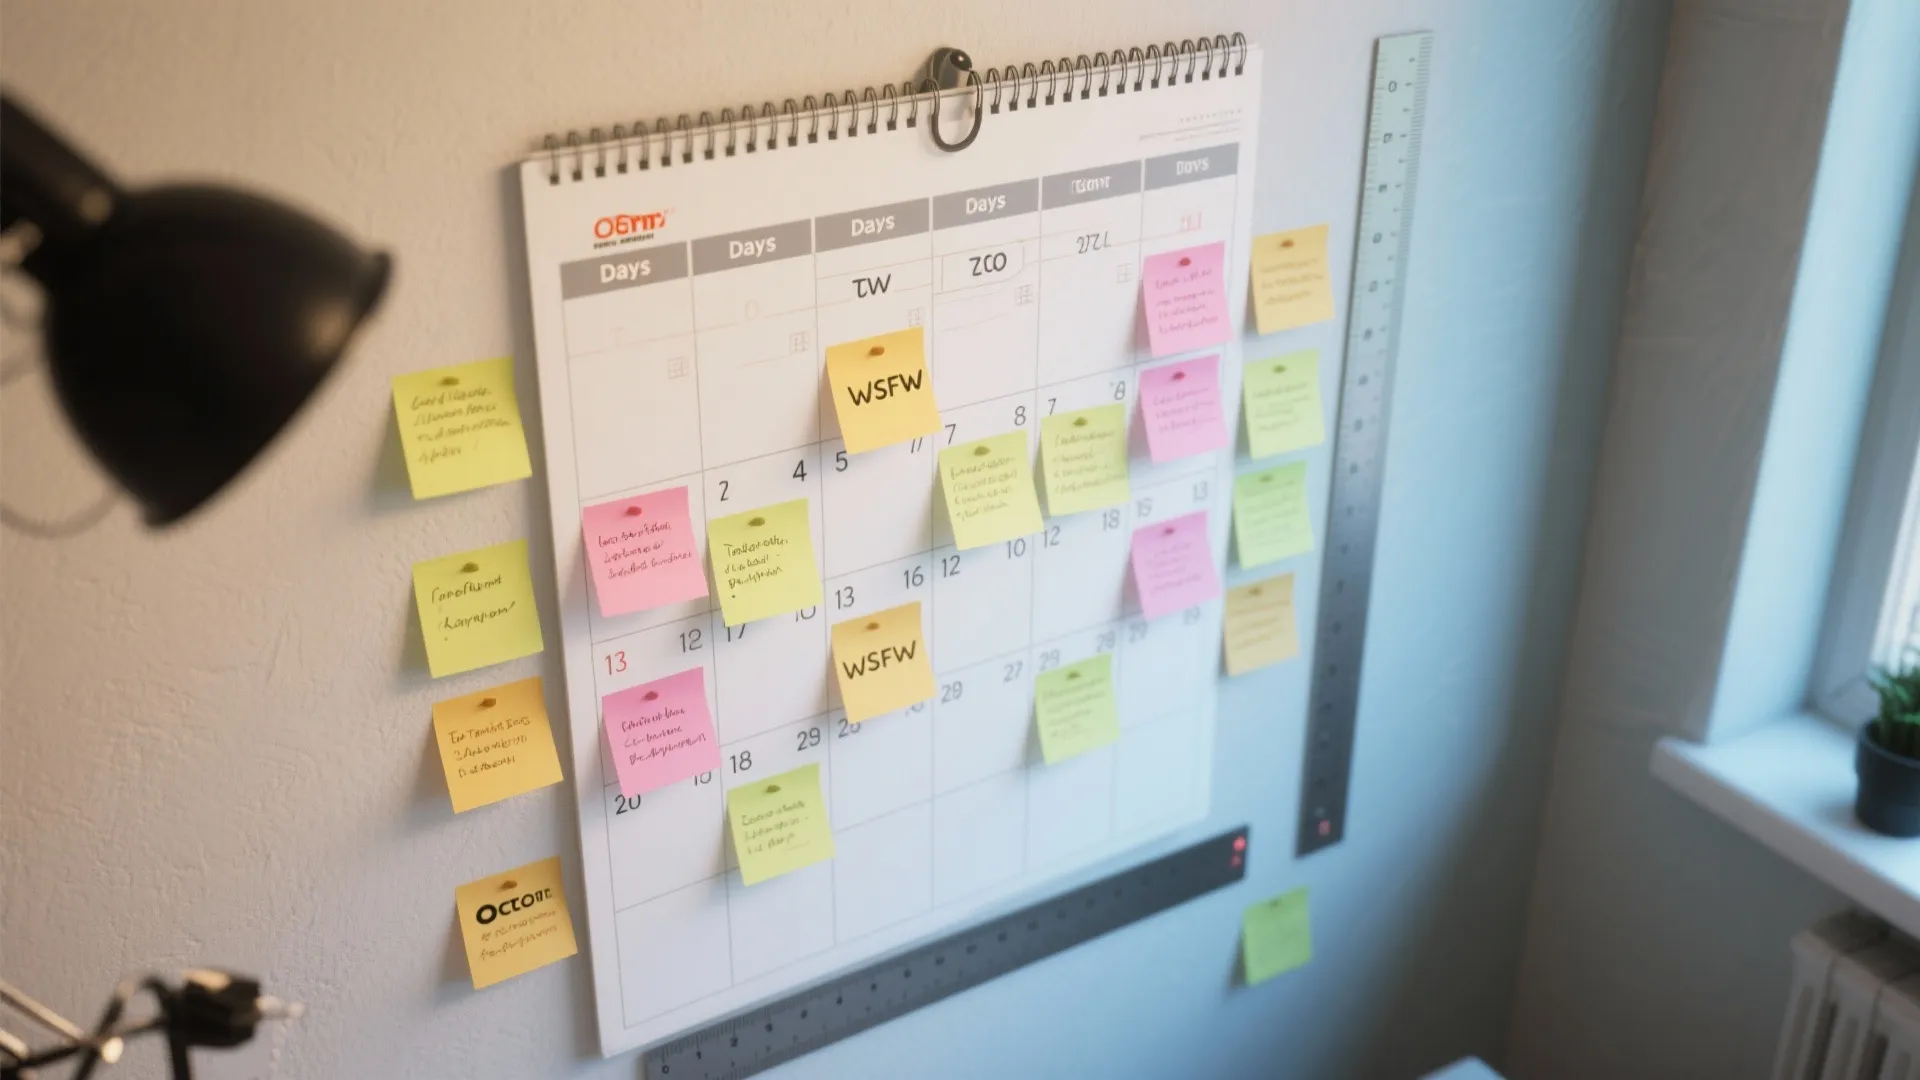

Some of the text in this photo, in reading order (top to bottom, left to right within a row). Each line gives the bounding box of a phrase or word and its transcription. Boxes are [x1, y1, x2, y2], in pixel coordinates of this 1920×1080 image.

[965, 194, 1006, 215] Days
[851, 214, 895, 237] Days
[729, 237, 777, 260] Days
[600, 258, 651, 283] Days
[847, 369, 923, 407] WSFW
[1014, 406, 1027, 426] 8
[944, 424, 957, 445] 7
[792, 460, 807, 482] 4
[835, 450, 849, 472] 5
[718, 481, 730, 501] 2
[1102, 509, 1121, 532] 18
[1007, 538, 1026, 559] 10
[1043, 526, 1061, 549] 12
[903, 566, 924, 589] 16
[942, 555, 961, 578] 12
[835, 586, 855, 610] 13
[679, 628, 703, 653] 12
[604, 651, 628, 676] 13
[843, 640, 917, 681] WSFW
[1003, 661, 1024, 683] 27
[941, 681, 964, 704] 29
[796, 727, 822, 752] 29
[729, 750, 753, 774] 18
